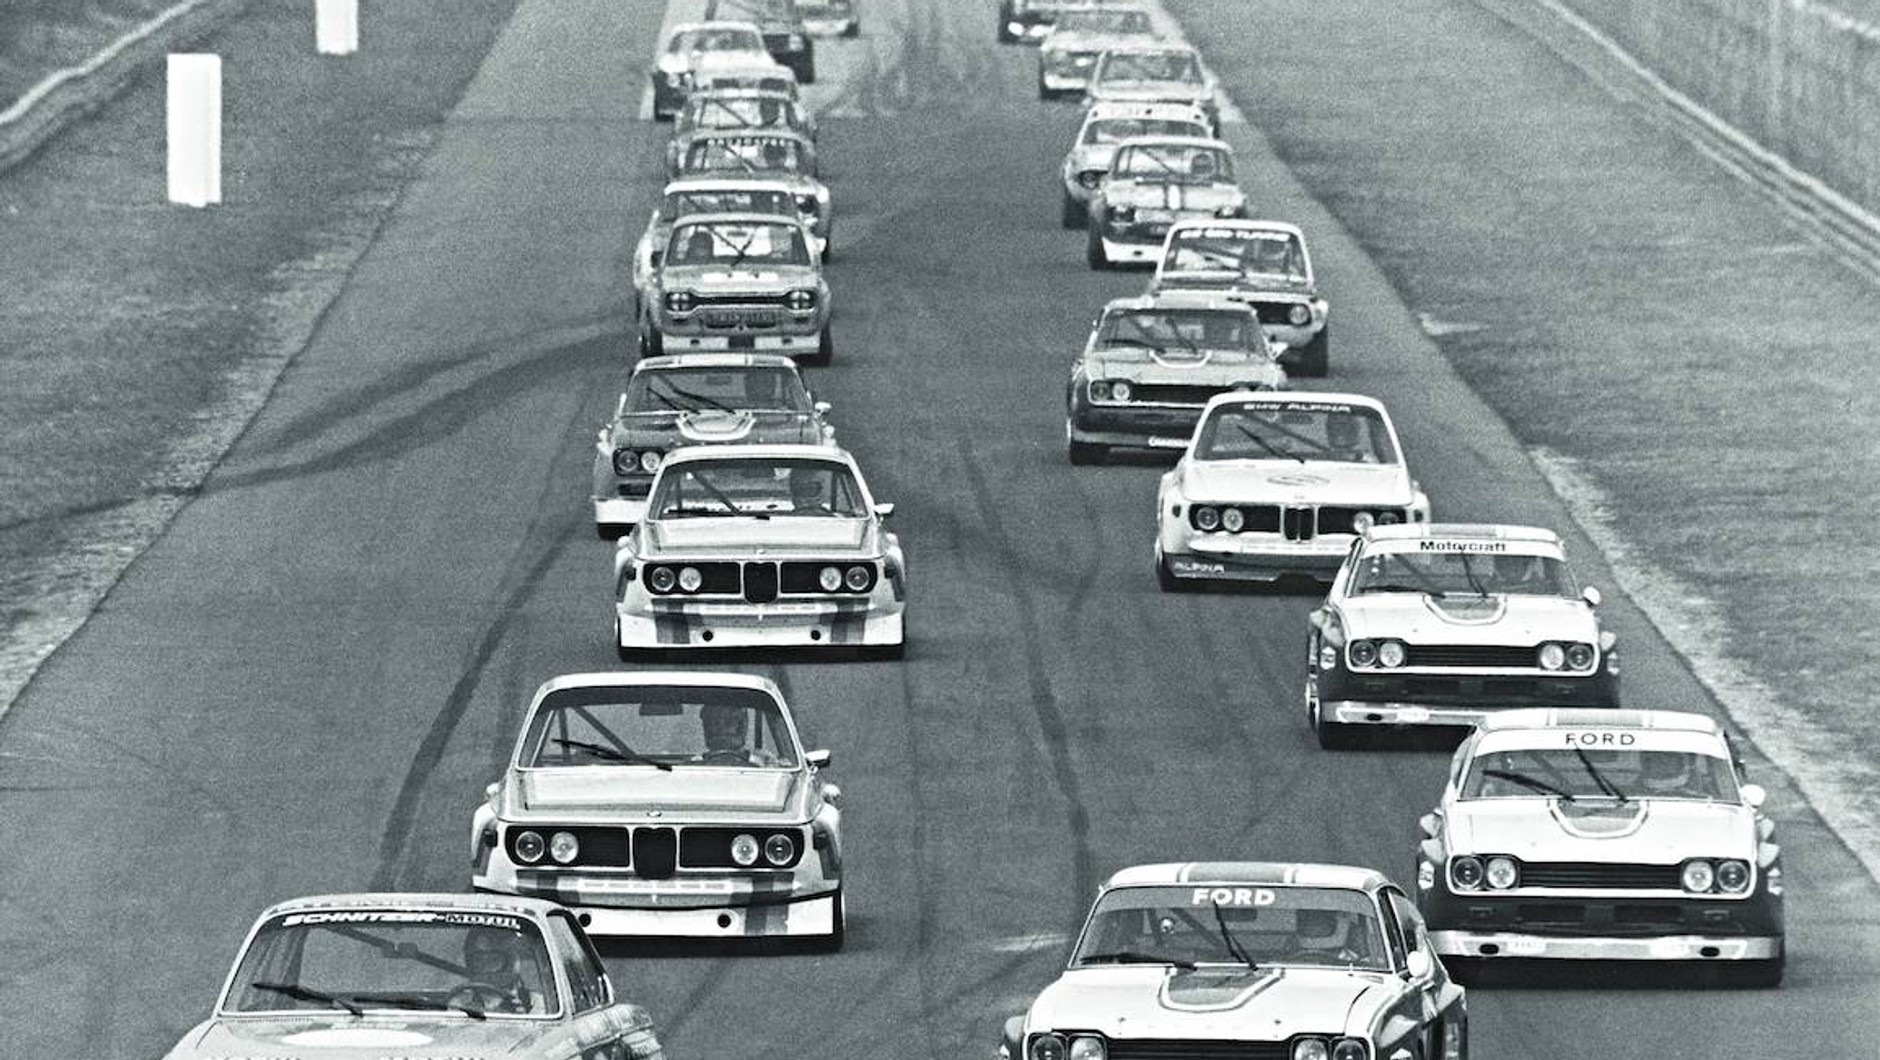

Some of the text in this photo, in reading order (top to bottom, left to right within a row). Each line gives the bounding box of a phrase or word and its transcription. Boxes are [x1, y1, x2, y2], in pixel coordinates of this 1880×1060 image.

[1420, 541, 1507, 552] Motorcraft
[1565, 732, 1635, 746] FORD
[1192, 888, 1275, 906] FORD
